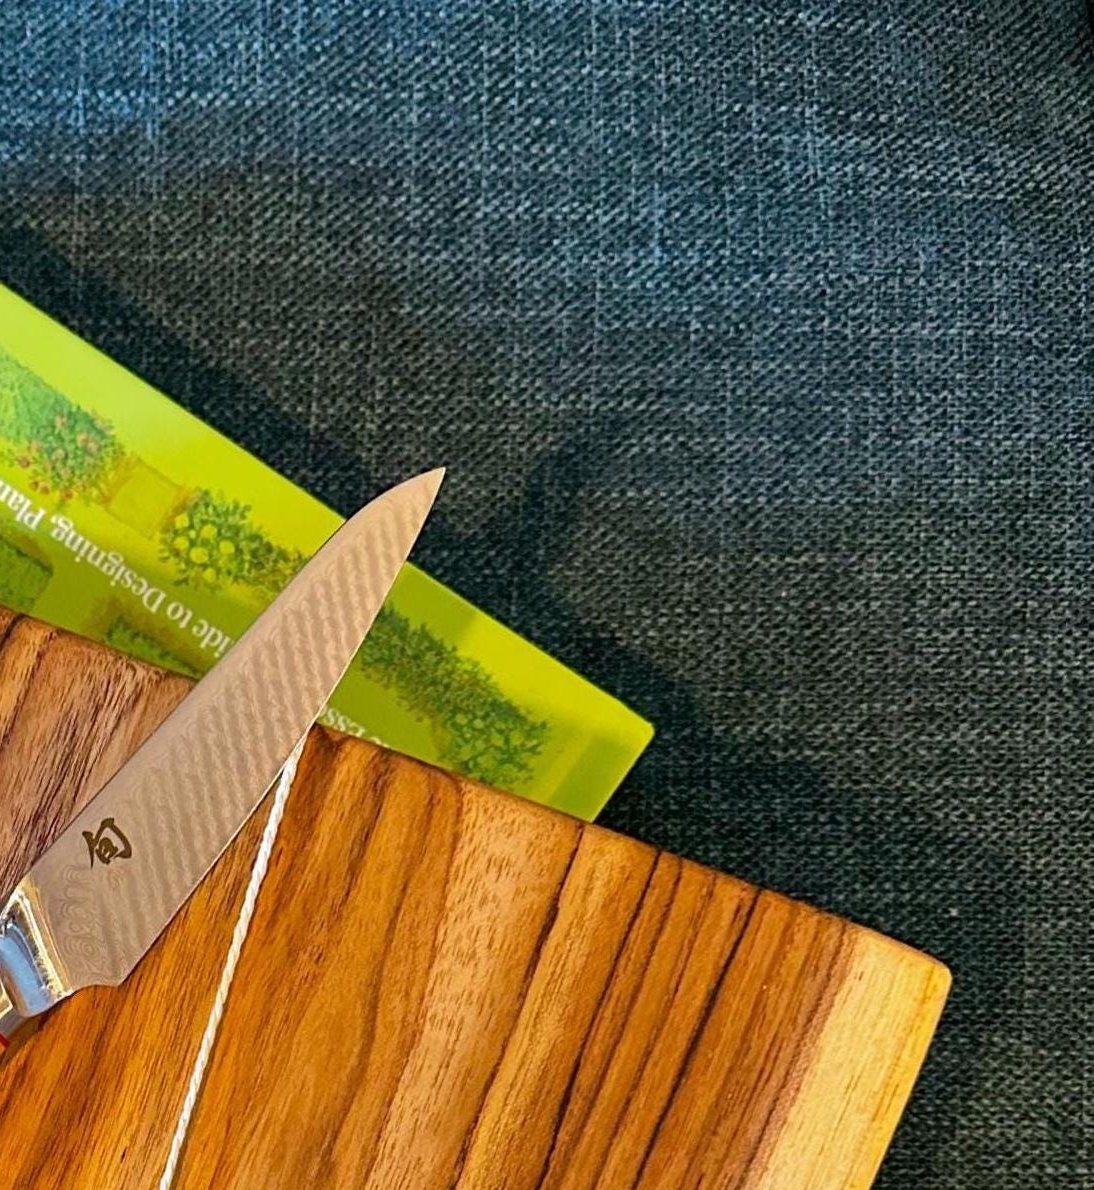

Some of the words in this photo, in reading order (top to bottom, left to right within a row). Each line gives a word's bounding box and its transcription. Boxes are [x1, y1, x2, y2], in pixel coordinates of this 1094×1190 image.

[50, 513, 167, 615] Designing,
[166, 600, 194, 630] to
[191, 624, 234, 659] ide
